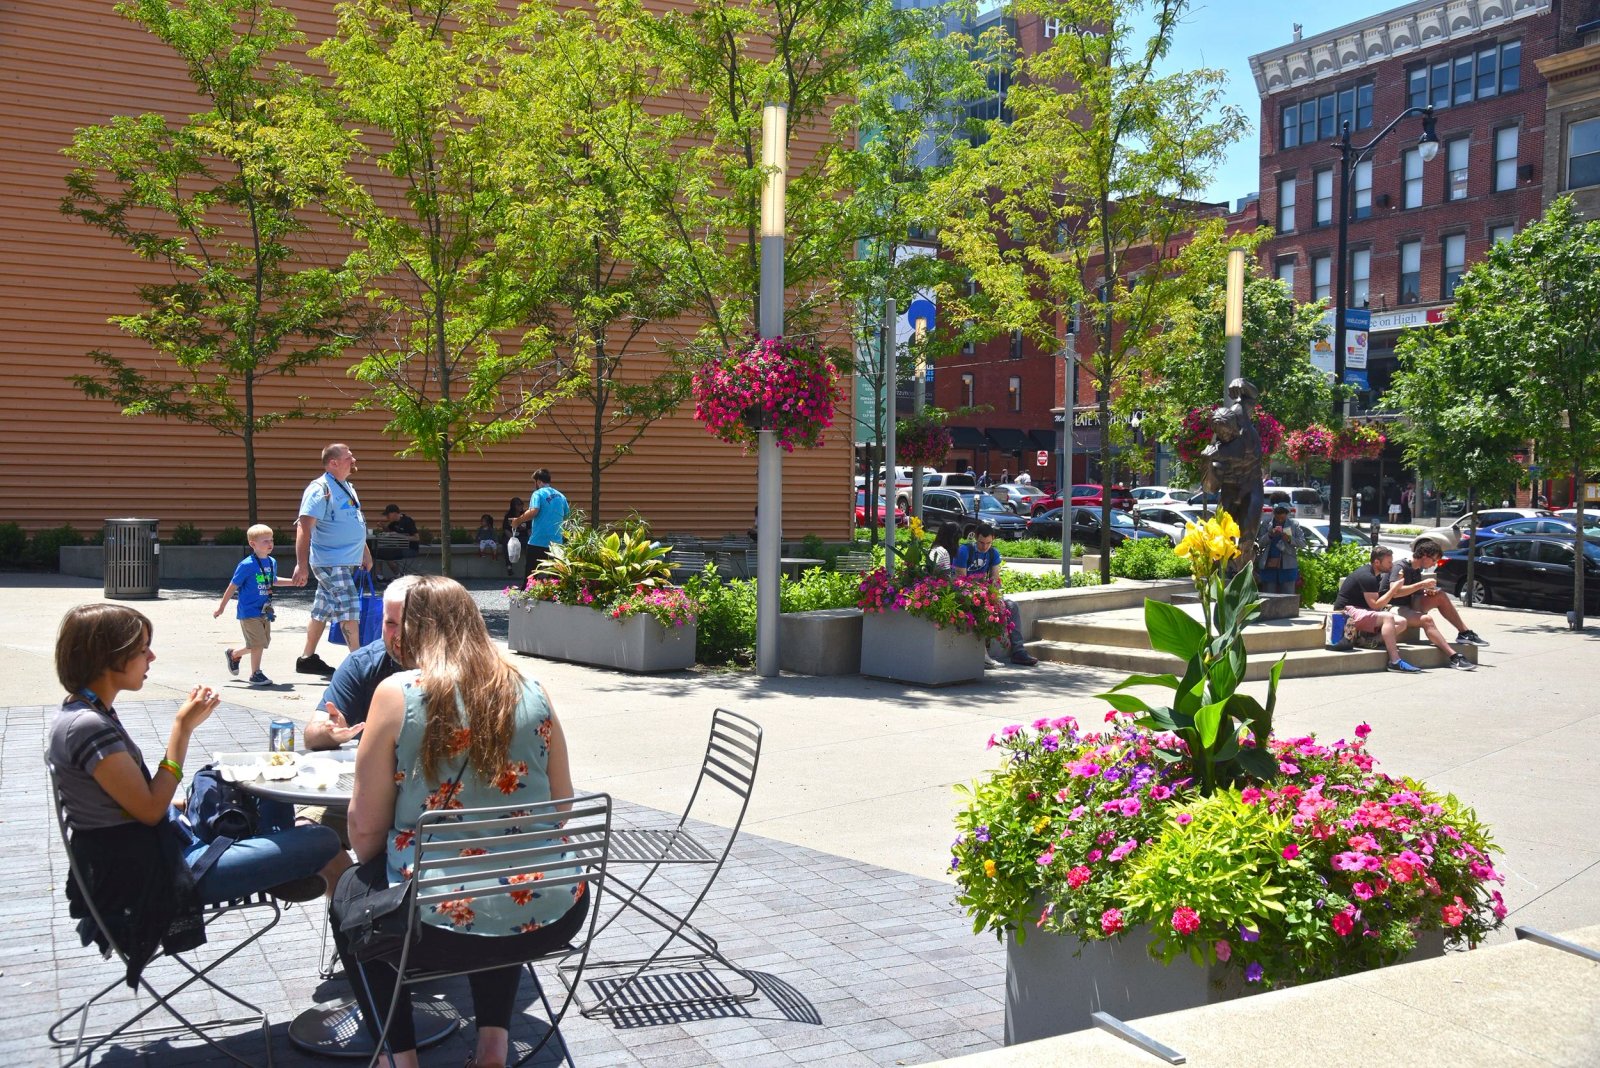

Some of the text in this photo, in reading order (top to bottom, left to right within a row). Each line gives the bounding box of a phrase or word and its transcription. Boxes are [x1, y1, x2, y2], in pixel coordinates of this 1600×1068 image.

[1044, 17, 1105, 40] Hilo
[1379, 318, 1391, 327] on
[1393, 313, 1417, 325] High
